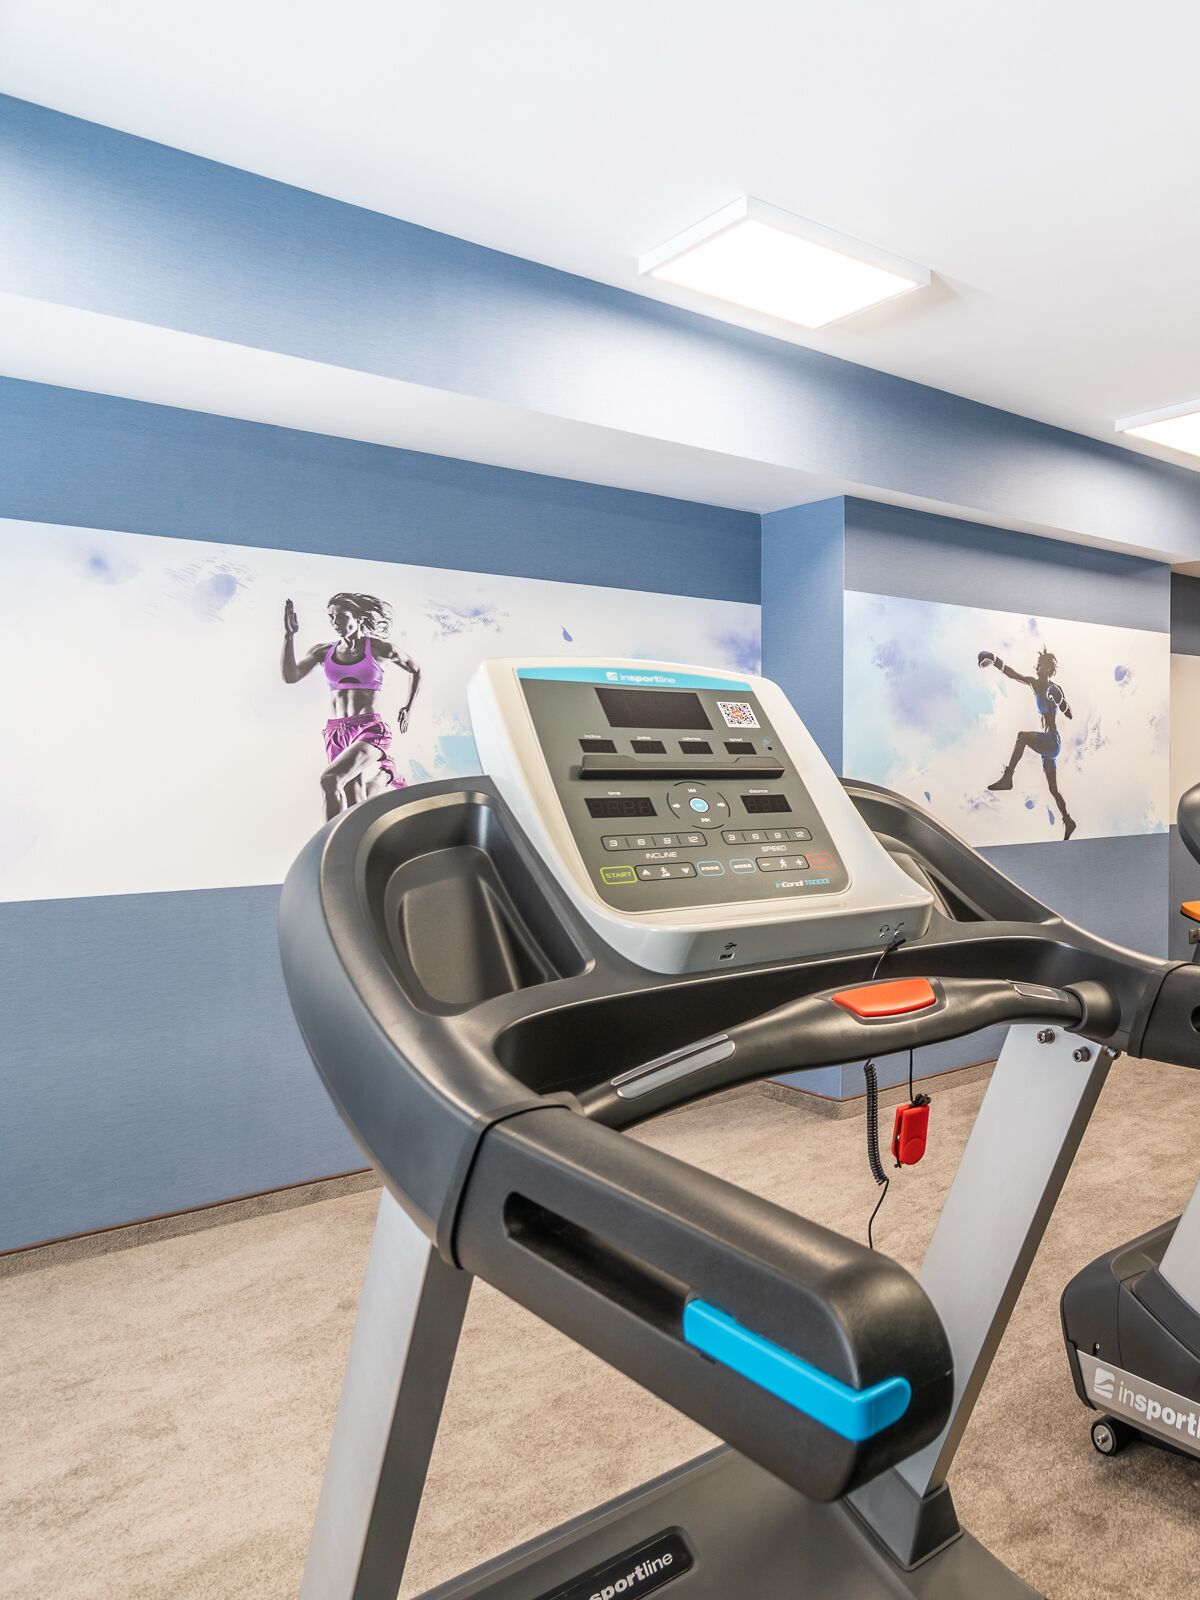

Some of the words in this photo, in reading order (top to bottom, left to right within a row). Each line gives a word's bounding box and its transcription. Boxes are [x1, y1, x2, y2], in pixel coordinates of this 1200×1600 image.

[620, 673, 676, 684] insportline
[608, 839, 618, 847] 3
[637, 838, 646, 846] 6
[645, 851, 678, 859] INCLINE
[605, 871, 632, 879] START
